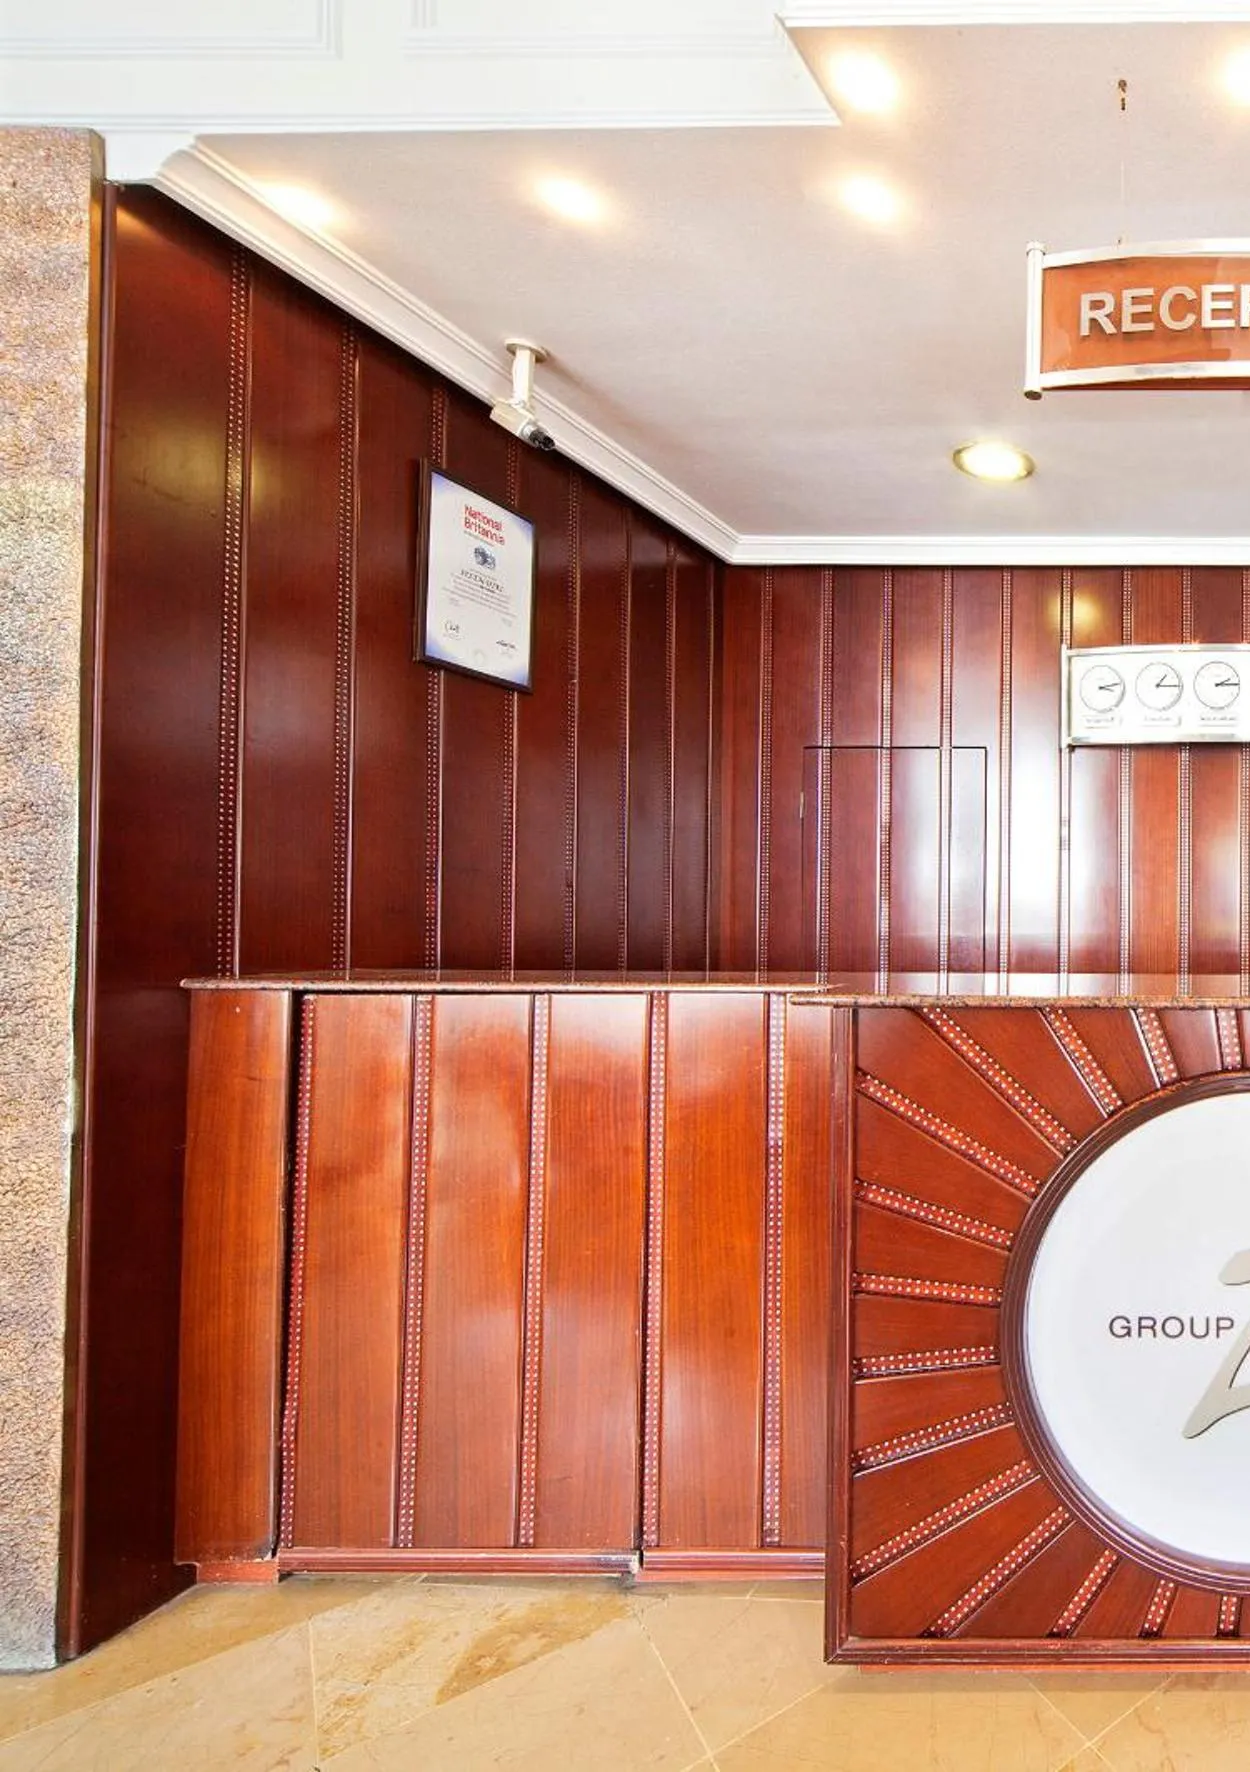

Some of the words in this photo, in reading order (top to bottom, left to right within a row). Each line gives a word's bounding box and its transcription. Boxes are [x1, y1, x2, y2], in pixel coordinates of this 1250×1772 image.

[463, 518, 506, 546] Britannia
[464, 505, 503, 532] National
[1108, 1315, 1235, 1339] GROUP
